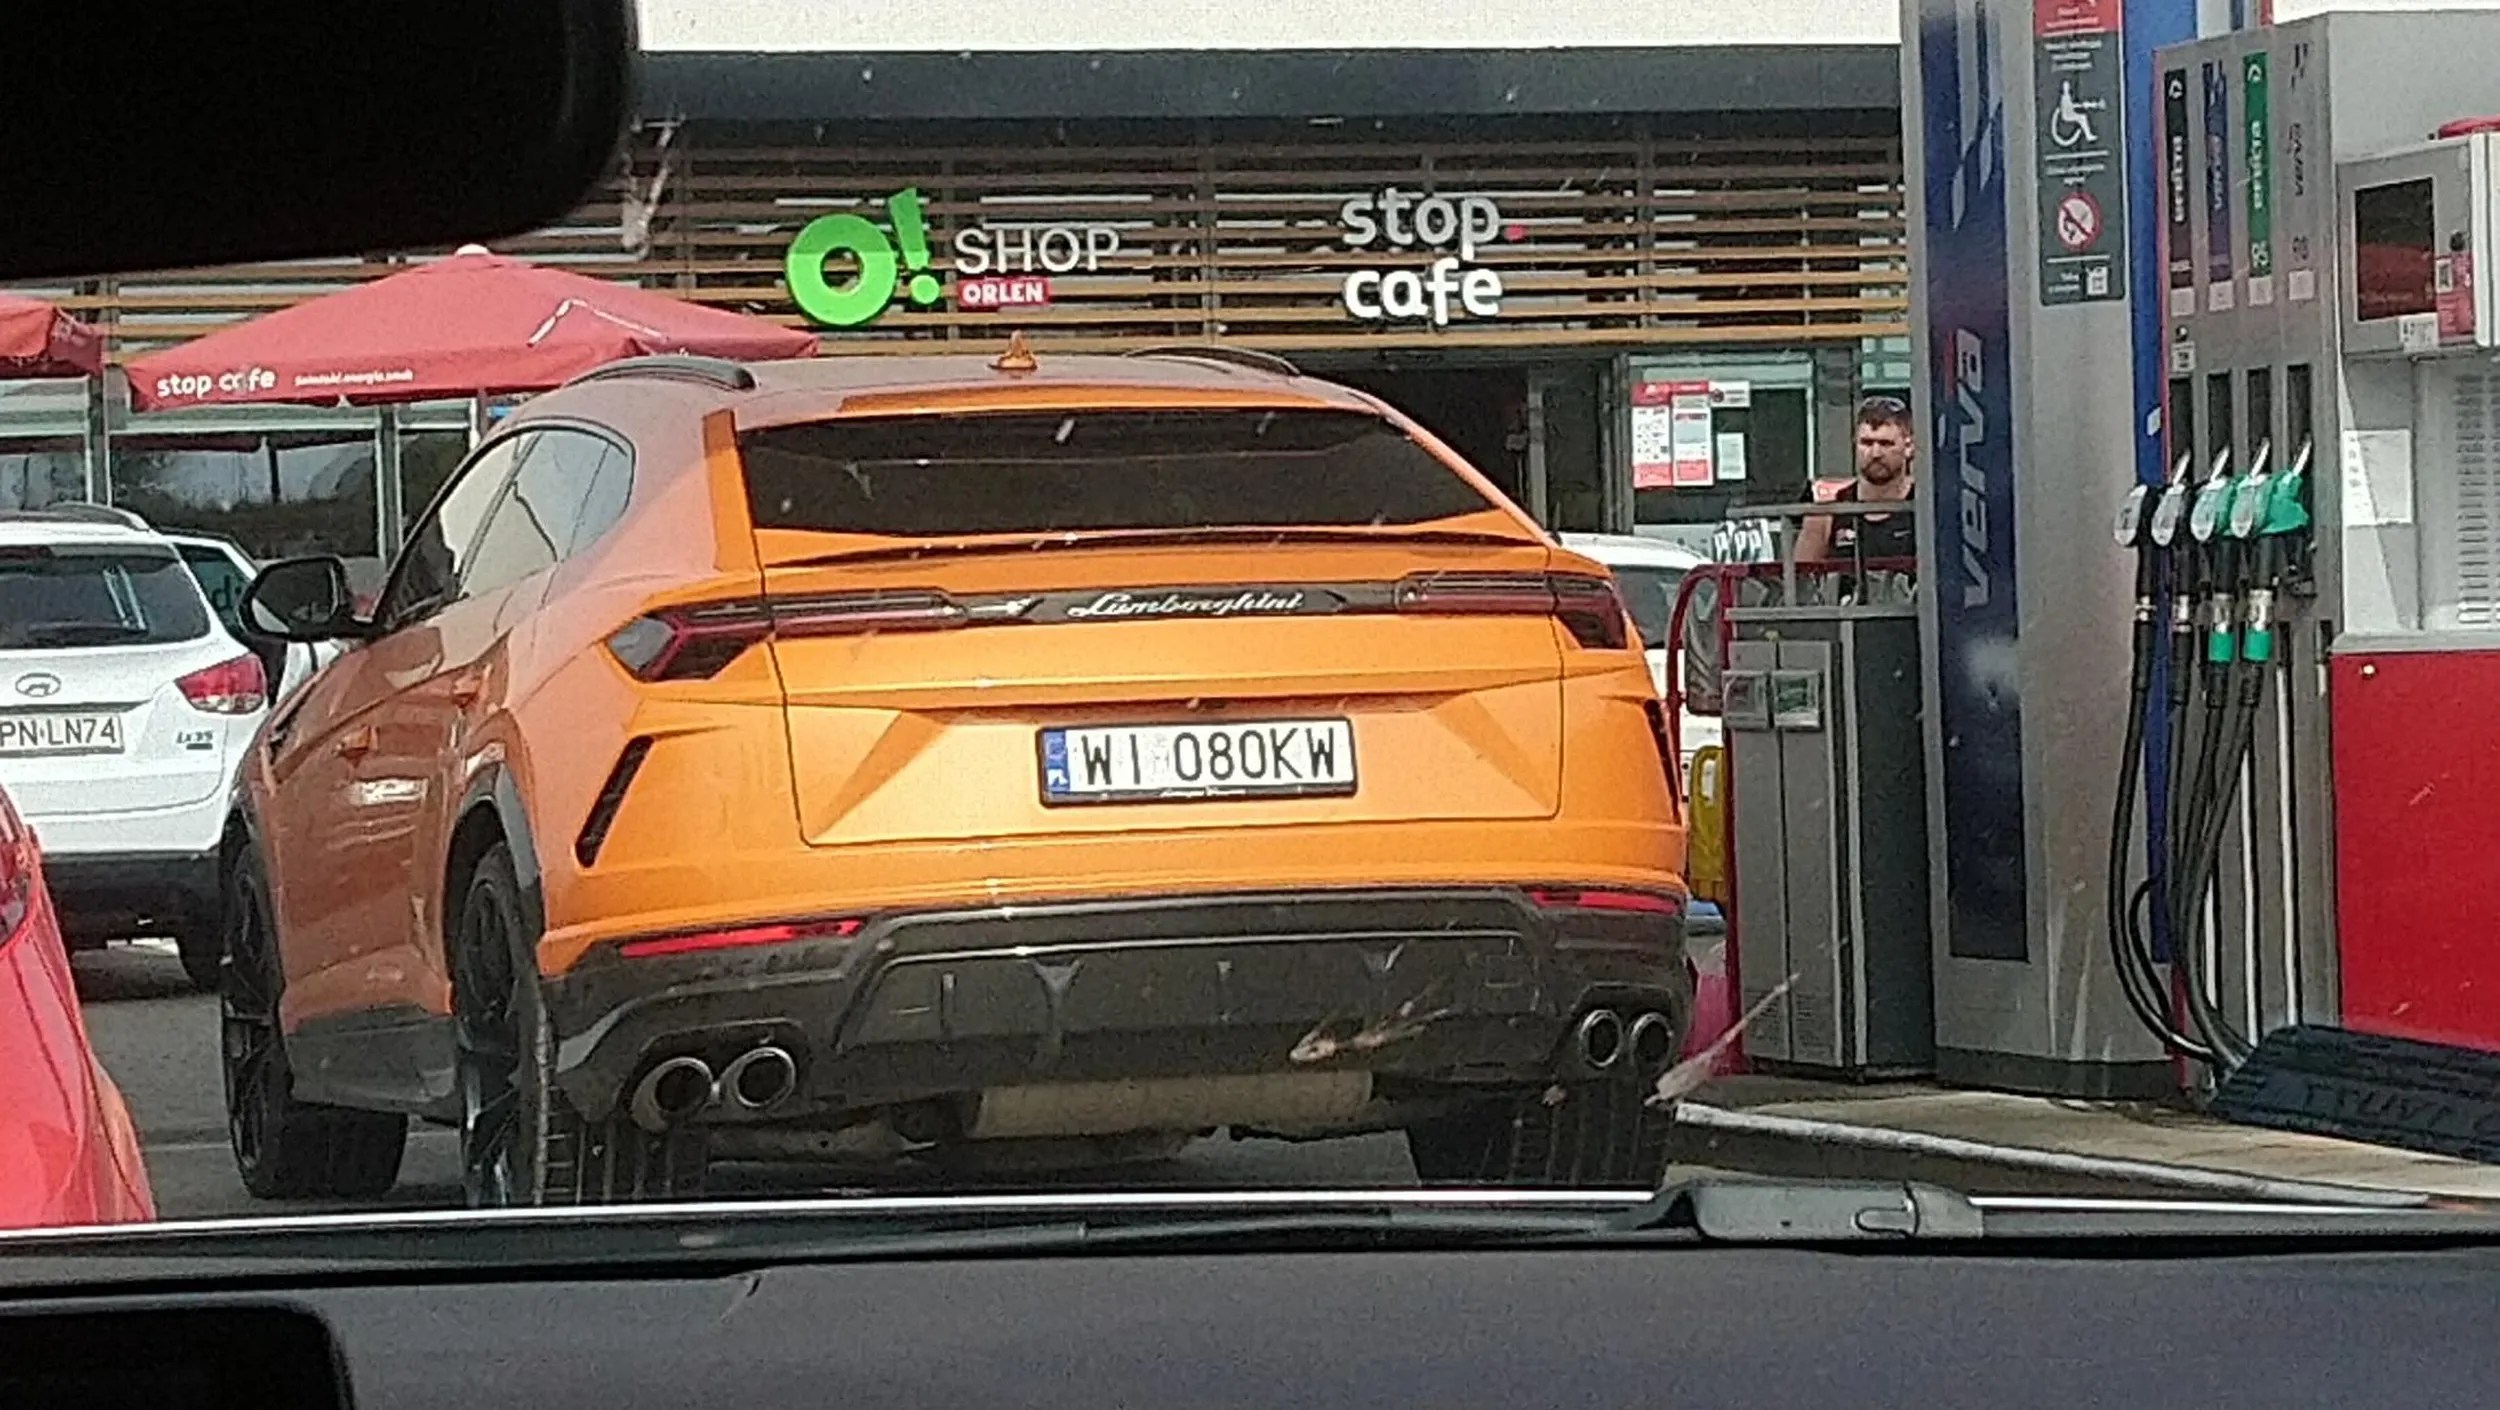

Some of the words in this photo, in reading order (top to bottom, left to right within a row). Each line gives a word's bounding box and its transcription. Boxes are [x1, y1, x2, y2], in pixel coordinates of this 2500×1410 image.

[954, 228, 1120, 274] SHOP
[962, 283, 1044, 305] ORLEN
[1345, 257, 1502, 326] cafe
[157, 374, 212, 398] stop
[1067, 591, 1305, 617] Lamborghini
[46, 716, 117, 746] LN74
[1081, 732, 1141, 785] WI
[1174, 727, 1336, 782] 080KW
